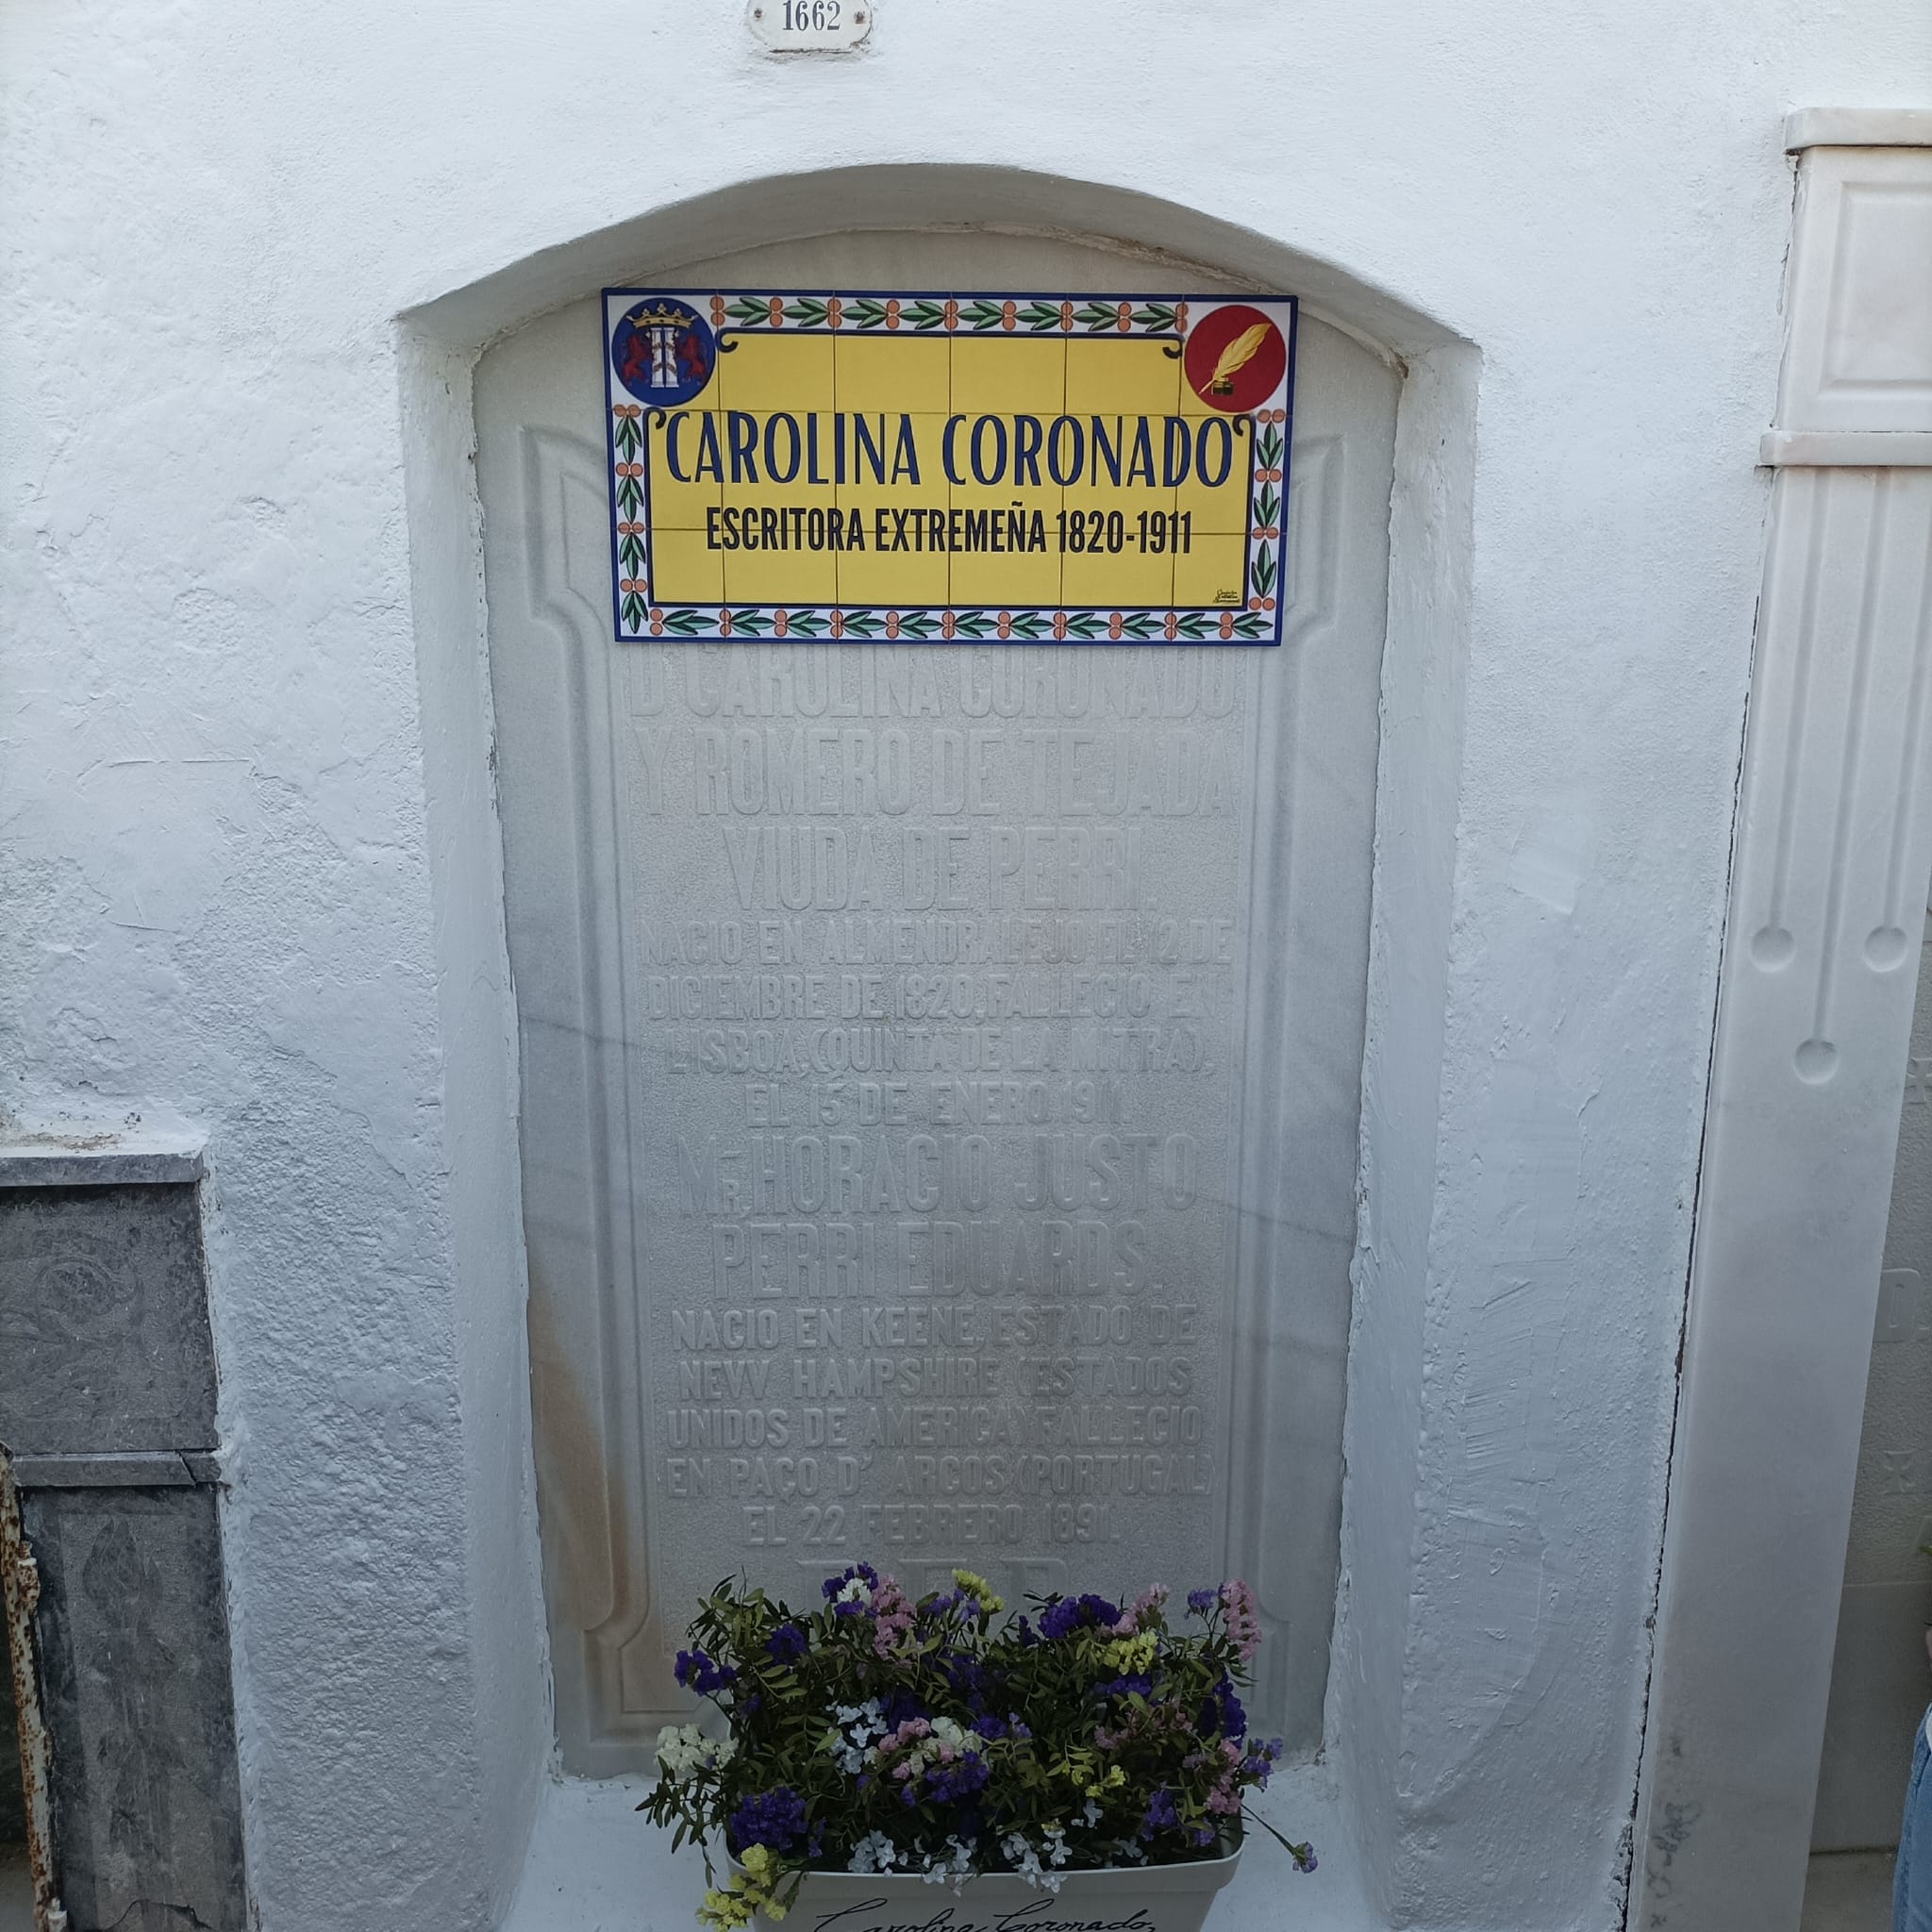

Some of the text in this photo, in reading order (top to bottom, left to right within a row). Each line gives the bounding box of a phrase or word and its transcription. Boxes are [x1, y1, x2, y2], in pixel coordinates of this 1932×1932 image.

[782, 0, 841, 31] 1662
[665, 411, 1232, 487] CAROLINA CORONADO
[706, 501, 1191, 555] ESCRITORA EXTREMEÑA 1820-1911
[686, 643, 943, 718] CAROLINA
[958, 643, 1236, 719] CORONADO
[635, 727, 1233, 817] Y ROMERO DE TEJADA
[724, 826, 885, 911] VIUDA
[903, 826, 973, 911] DE
[640, 920, 742, 965] NACIO
[758, 920, 805, 964] EN
[820, 919, 1087, 964] ALMENDRALEJO
[1096, 920, 1135, 965] EL
[1187, 919, 1232, 965] DE
[648, 974, 826, 1020] DICIEMBRE
[840, 974, 885, 1020] DE
[988, 974, 1150, 1019] FALLECIO
[1169, 973, 1219, 1020] EN
[960, 1027, 1001, 1072] DE
[1010, 1027, 1058, 1072] LA
[745, 1084, 791, 1128] EL
[810, 1083, 842, 1127] 15
[859, 1081, 908, 1126] DE
[930, 1080, 1051, 1125] ENERO
[753, 1134, 992, 1215] HORACIO
[1015, 1133, 1198, 1213] JUSTO
[712, 1222, 876, 1300] PERRI
[672, 1307, 779, 1351] NACIO
[795, 1307, 842, 1349] EN
[991, 1304, 1132, 1347] ESTADO
[1150, 1303, 1199, 1346] DE
[794, 1357, 1000, 1399] HAMPSHIRE
[1014, 1356, 1192, 1398] (ESTADOS
[666, 1404, 1202, 1450] UNIDOS DE AMERICA) FALLECIO
[666, 1457, 712, 1498] EN
[729, 1456, 820, 1506] PAÇO
[889, 1455, 1005, 1497] ARCOS
[1016, 1454, 1217, 1496] (PORTUGAL)
[742, 1506, 788, 1547] EL
[802, 1505, 848, 1545] 22
[861, 1504, 1024, 1545] FEBRERO
